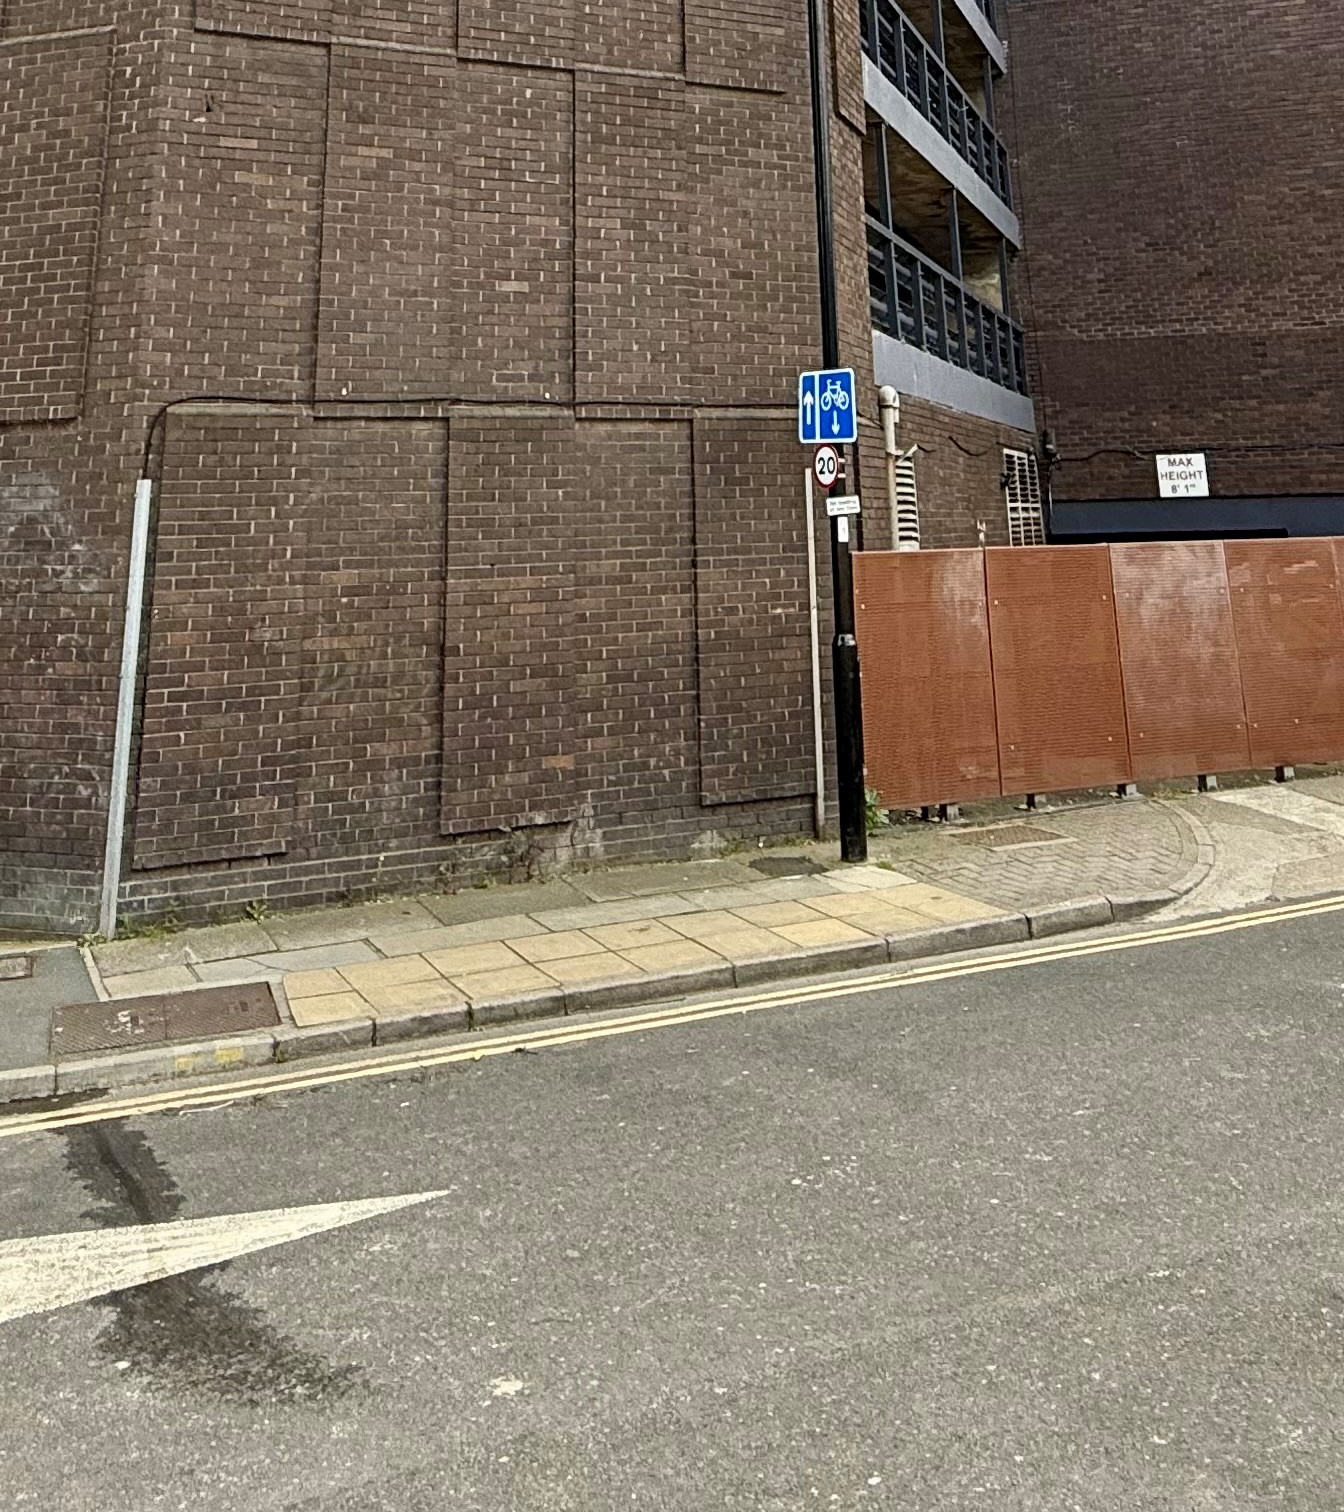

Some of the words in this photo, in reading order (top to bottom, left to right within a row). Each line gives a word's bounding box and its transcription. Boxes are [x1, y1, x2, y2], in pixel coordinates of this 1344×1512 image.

[818, 457, 835, 475] 20
[1168, 457, 1193, 467] MAX
[1160, 470, 1203, 481] HEIGHT
